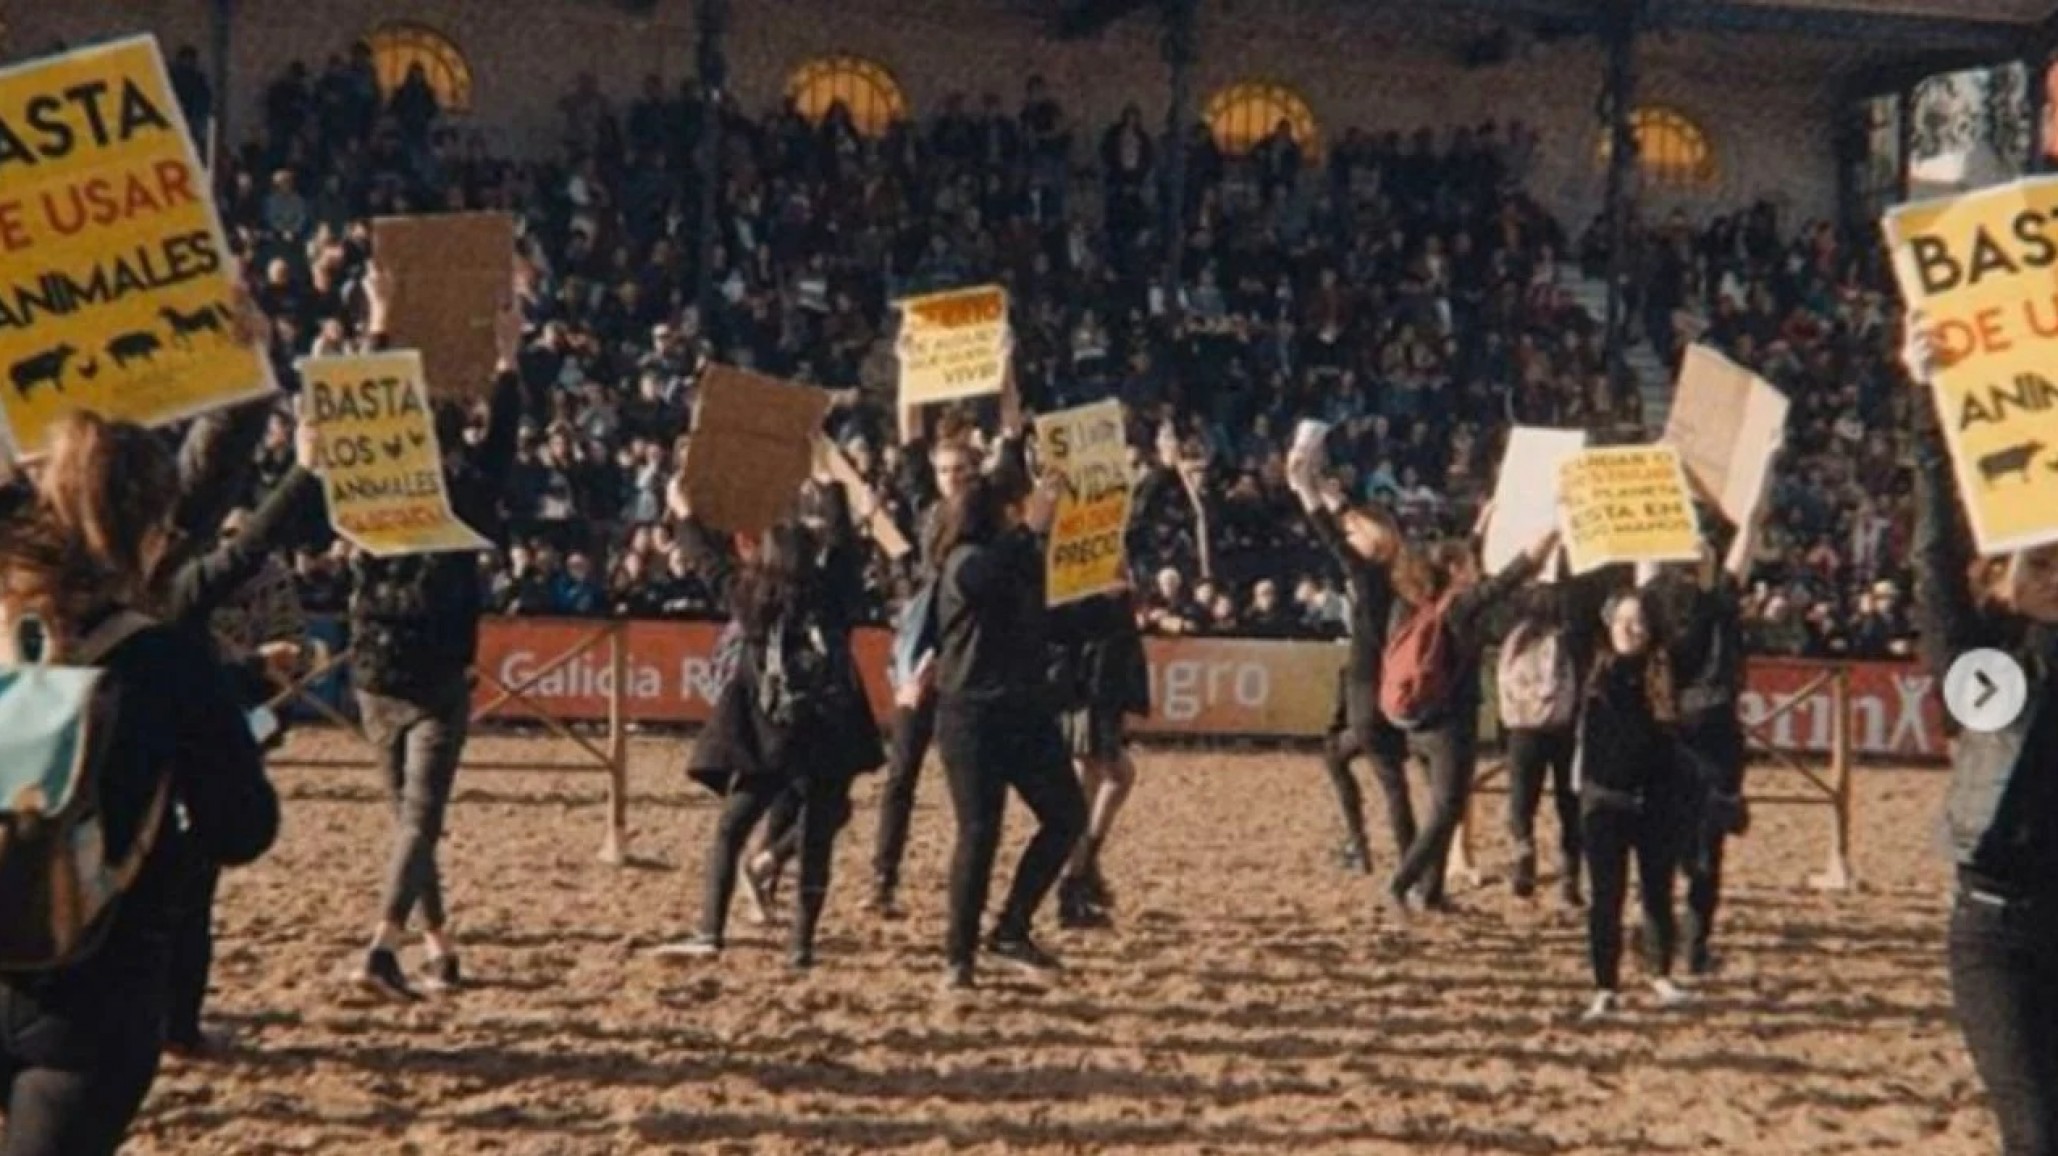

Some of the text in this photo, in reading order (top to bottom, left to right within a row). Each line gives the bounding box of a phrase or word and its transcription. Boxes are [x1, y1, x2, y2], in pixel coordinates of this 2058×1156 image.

[42, 160, 198, 236] USAR
[1910, 206, 2058, 296] BAS
[313, 377, 425, 424] BASTA
[319, 435, 377, 469] LOS
[501, 650, 662, 698] Galicia
